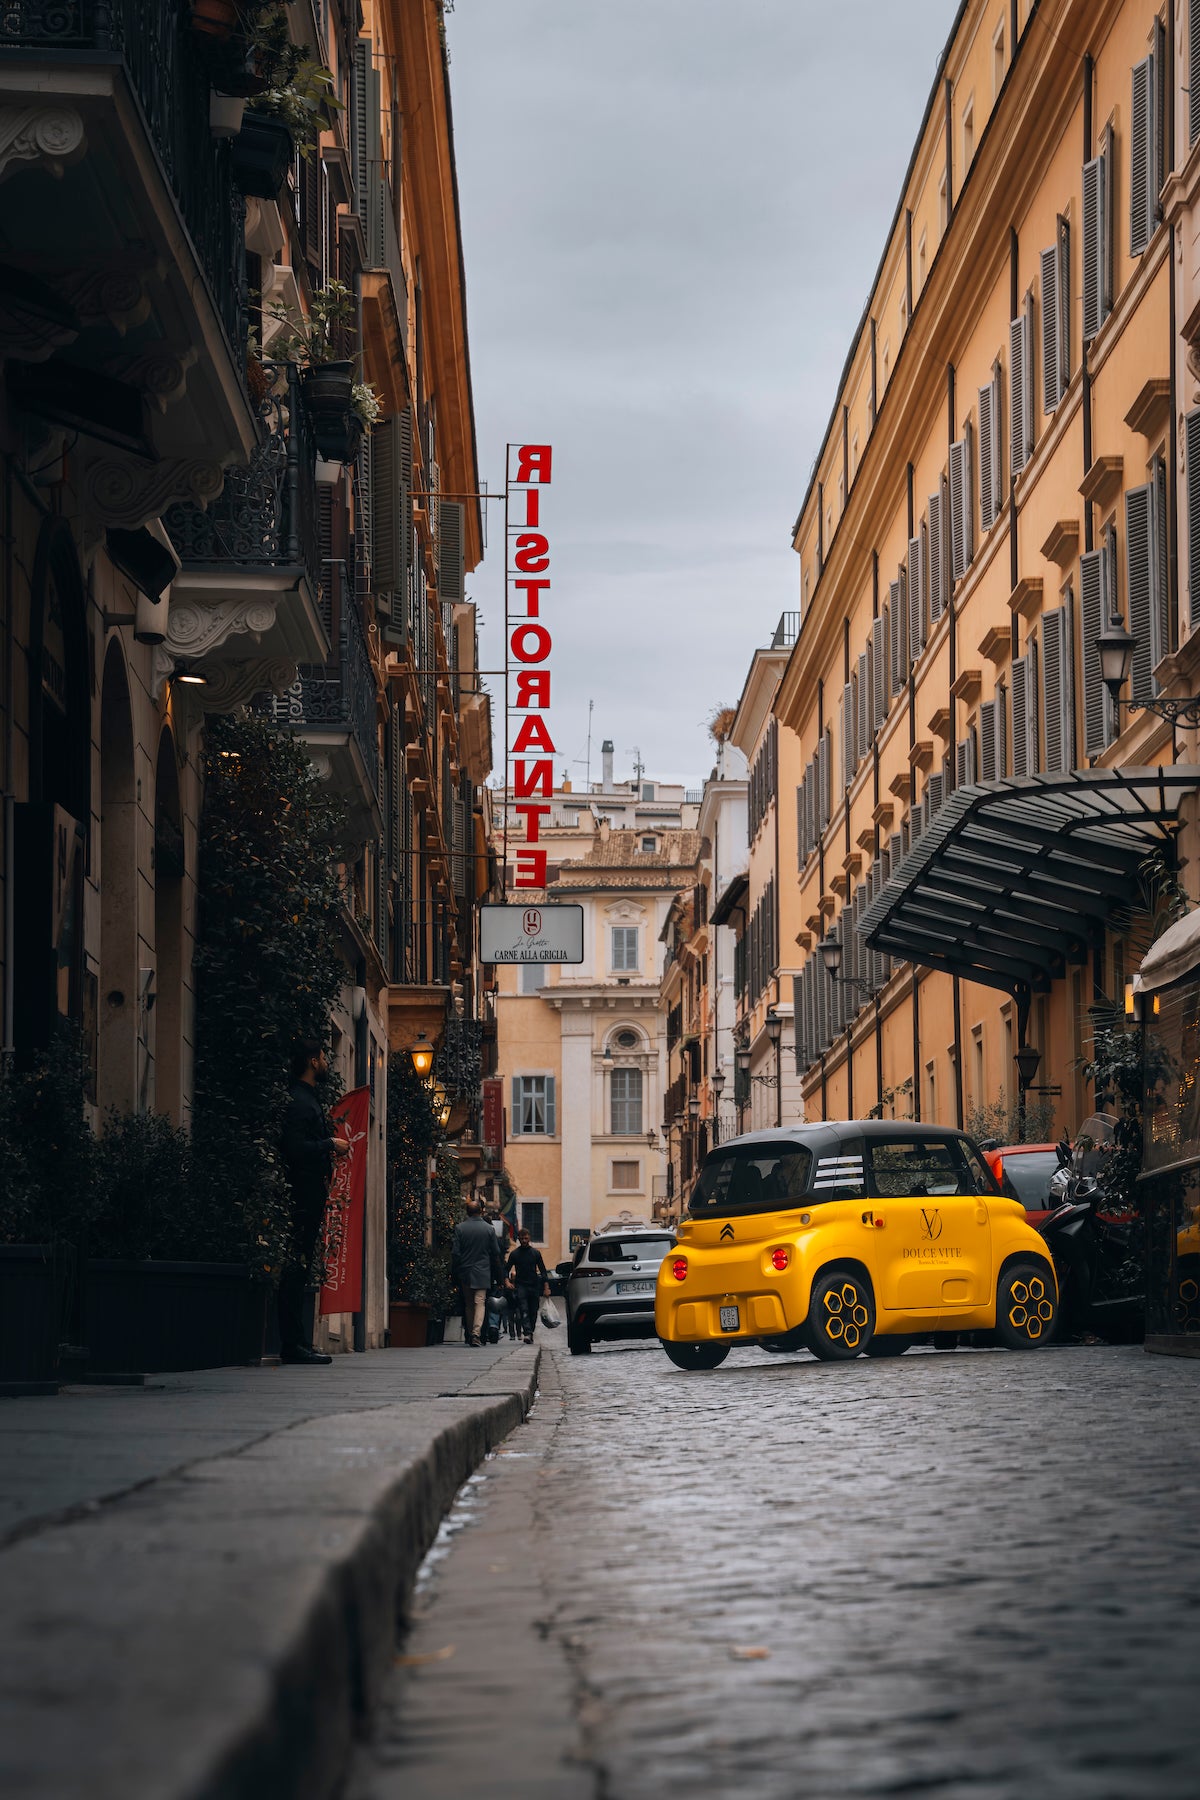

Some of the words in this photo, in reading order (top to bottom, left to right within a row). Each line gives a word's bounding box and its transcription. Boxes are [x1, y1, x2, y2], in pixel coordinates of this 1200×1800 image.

[494, 950, 518, 960] CARNE
[519, 950, 538, 960] ALLA
[539, 950, 568, 960] GRIGLIA
[903, 1248, 937, 1258] DOLCE
[938, 1247, 962, 1258] VITE
